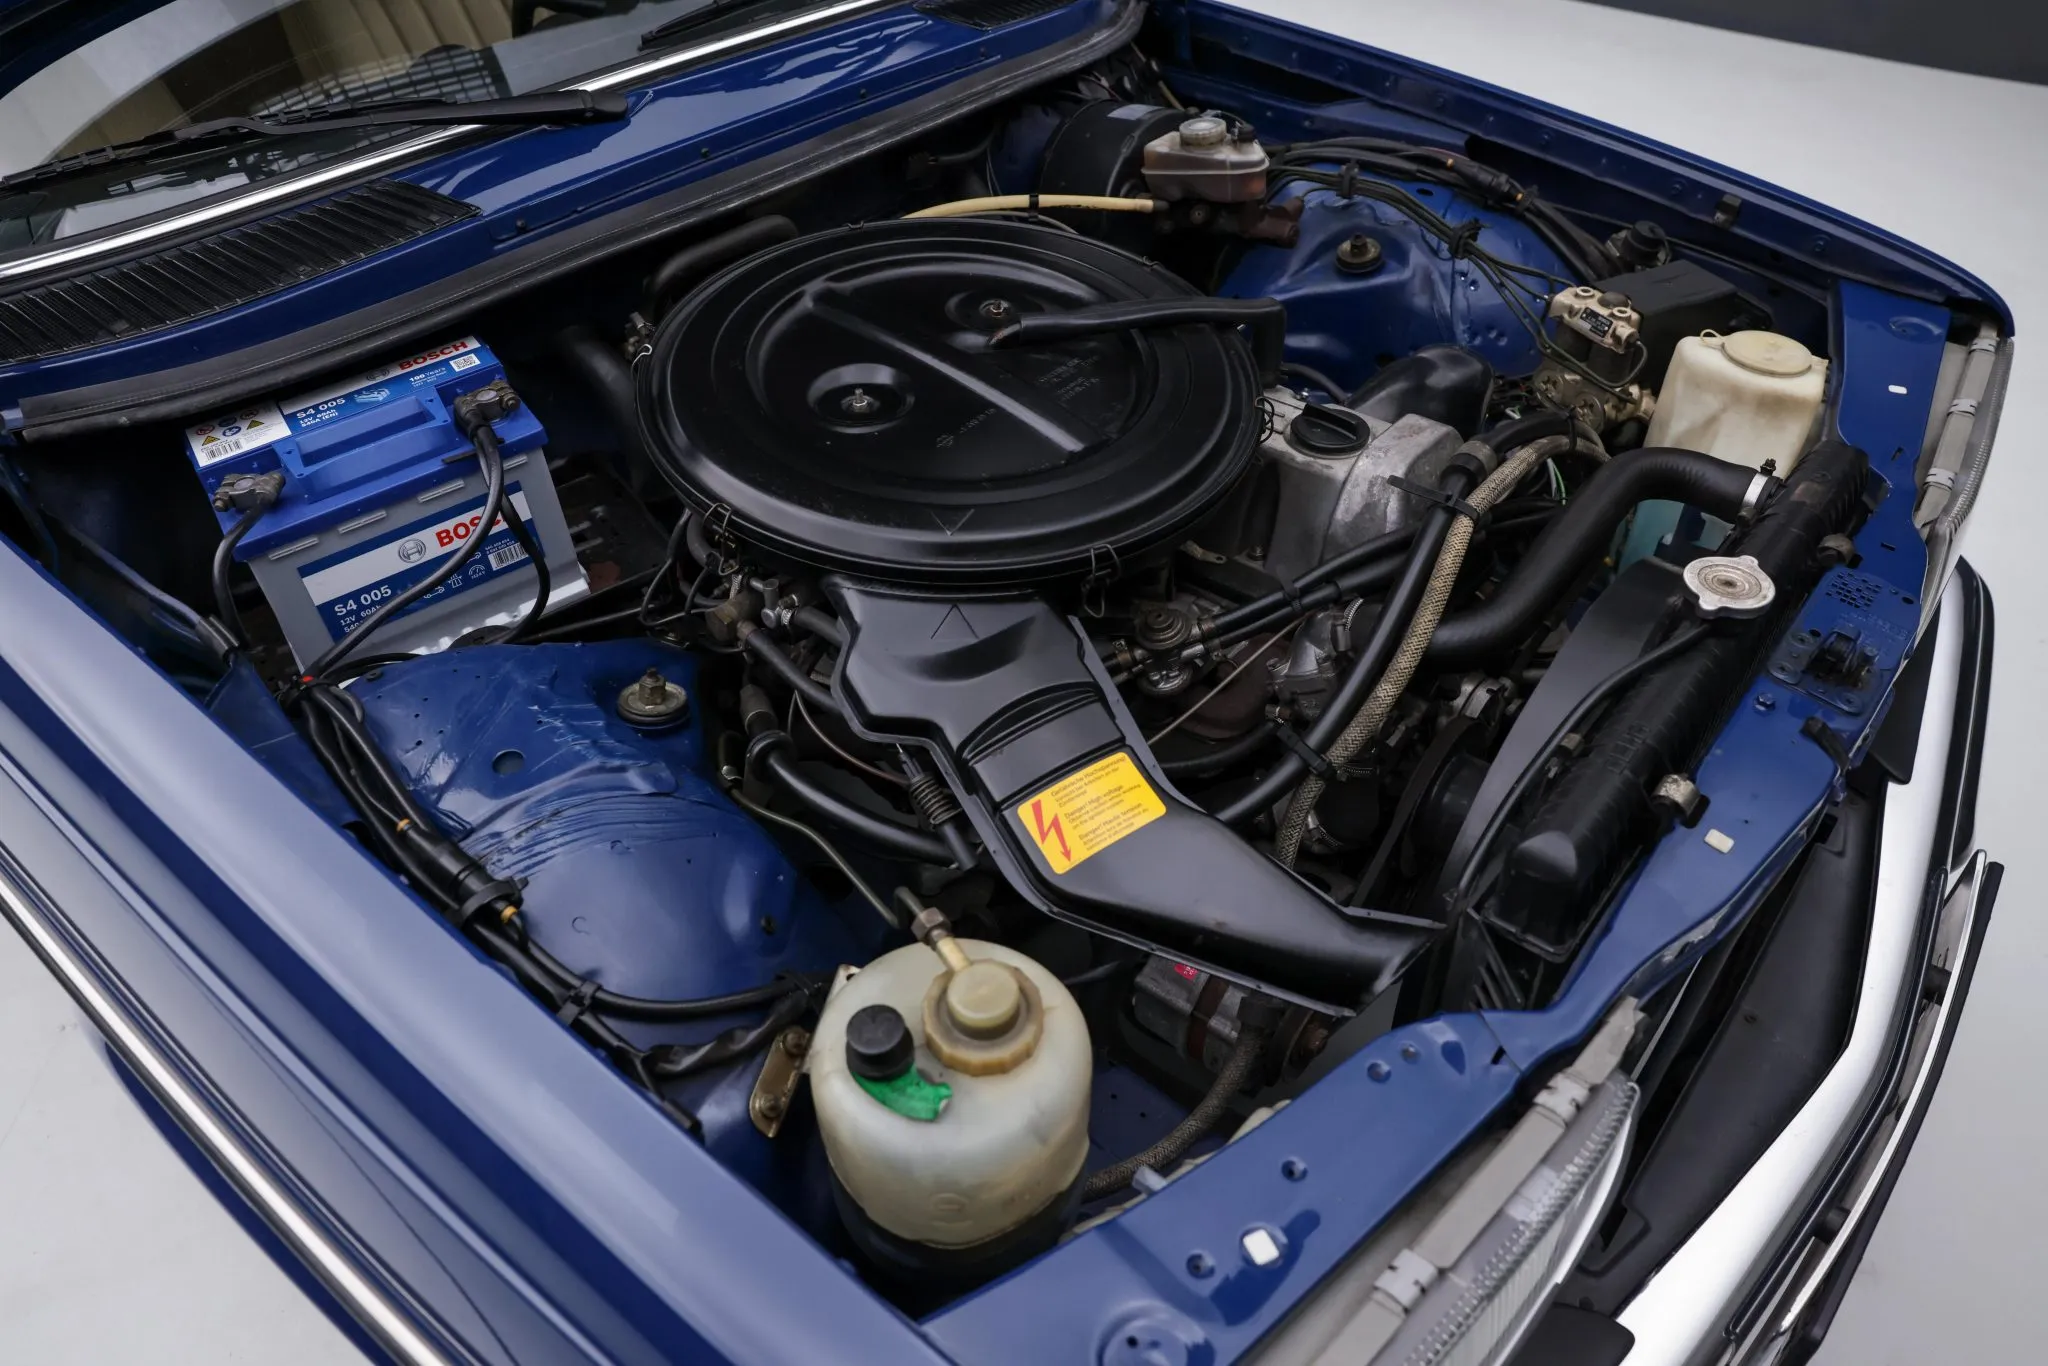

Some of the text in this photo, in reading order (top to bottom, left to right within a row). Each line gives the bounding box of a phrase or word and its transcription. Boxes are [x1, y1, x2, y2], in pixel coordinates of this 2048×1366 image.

[399, 341, 468, 370] BOSCH
[297, 397, 346, 419] S4 005
[435, 515, 503, 548] BOS
[335, 585, 392, 616] S4 005
[340, 615, 356, 626] 12V
